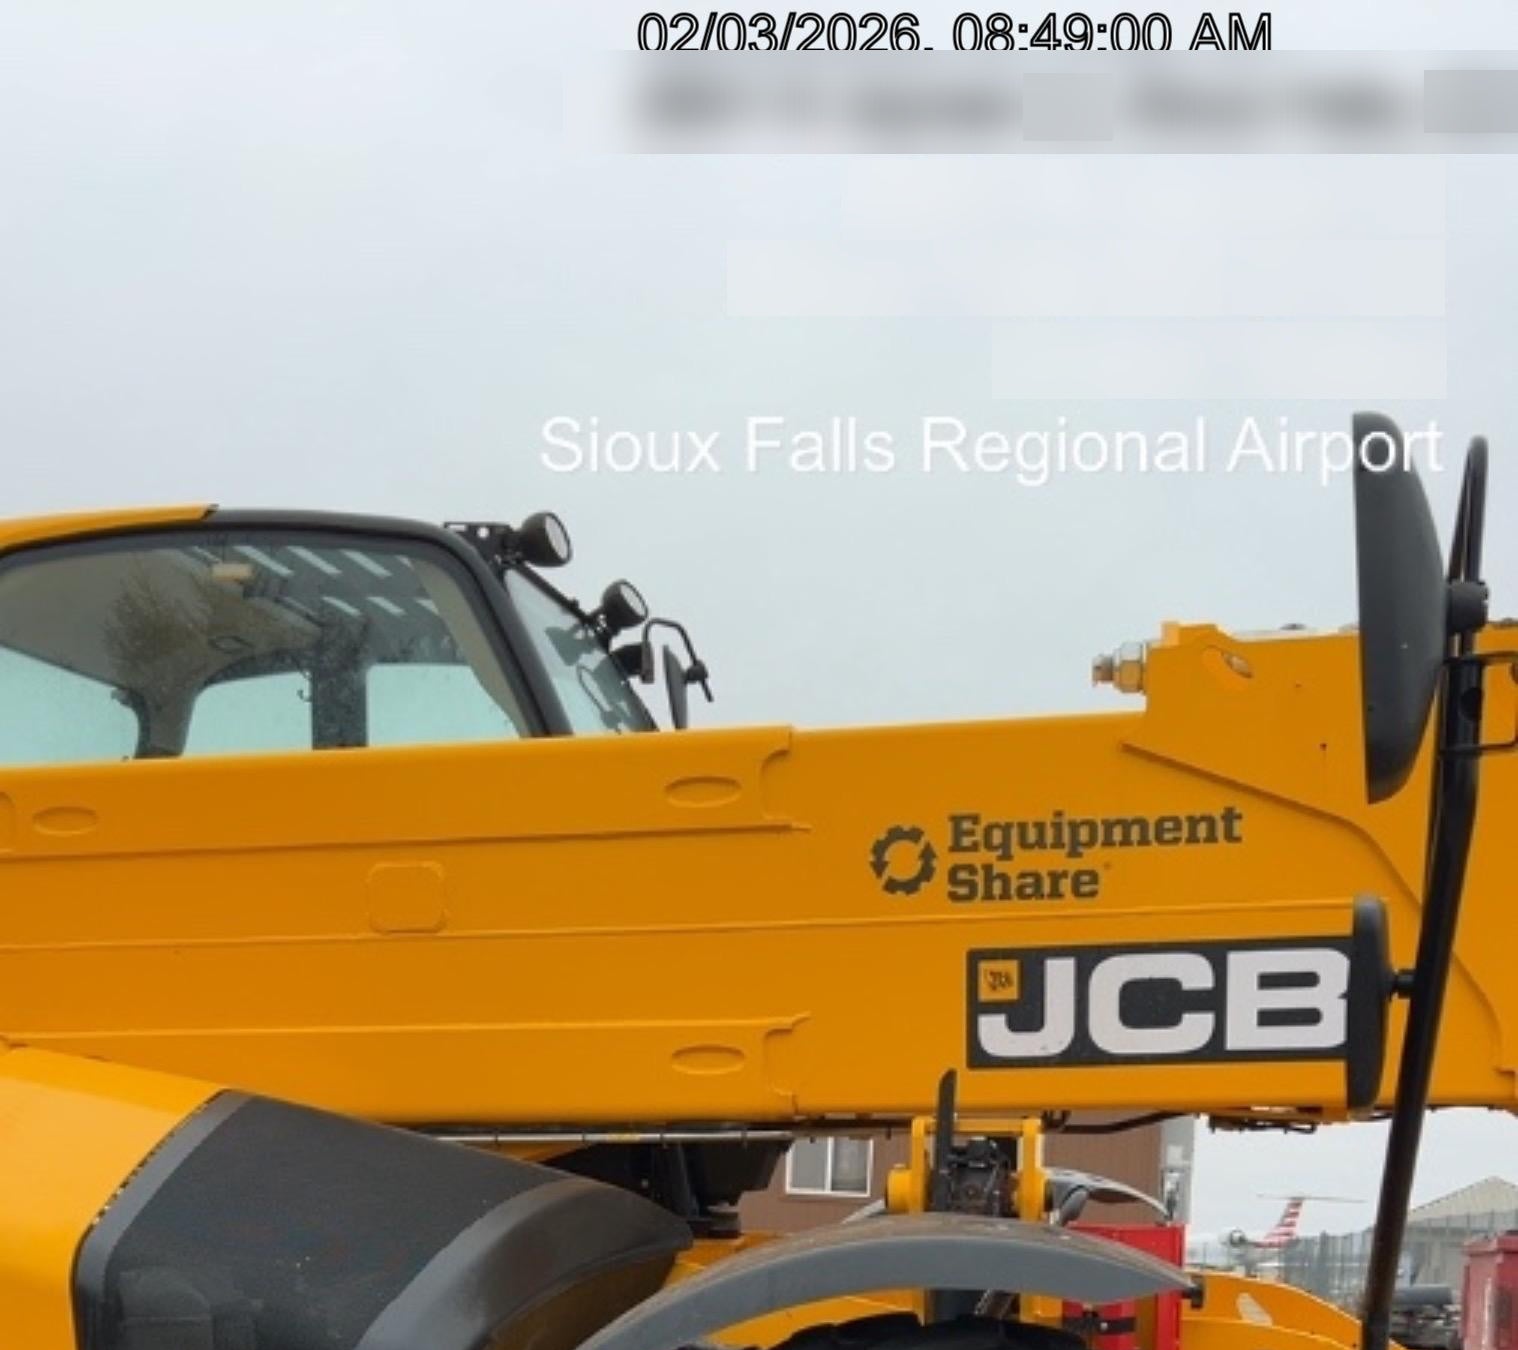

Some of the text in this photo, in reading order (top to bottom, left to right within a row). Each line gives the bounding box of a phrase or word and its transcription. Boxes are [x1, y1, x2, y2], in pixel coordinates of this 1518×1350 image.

[947, 806, 1243, 861] Equipment
[947, 863, 1100, 902] Share
[977, 947, 1351, 1058] JCB
